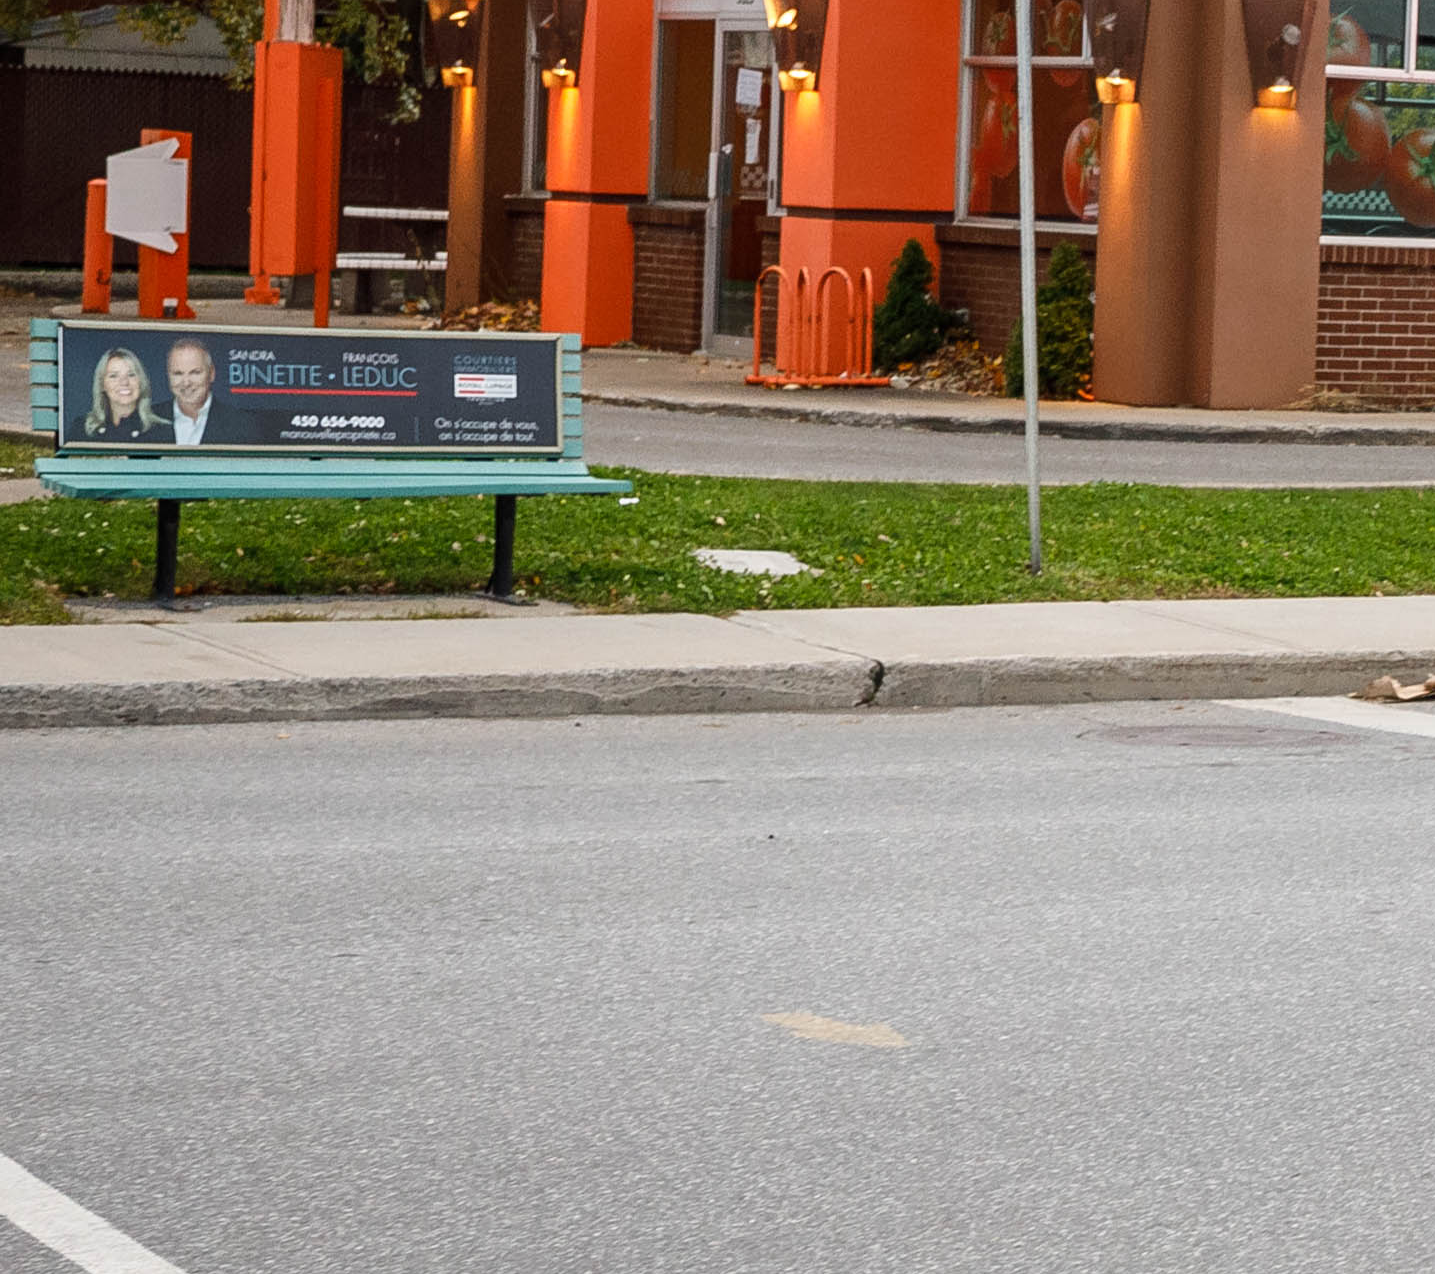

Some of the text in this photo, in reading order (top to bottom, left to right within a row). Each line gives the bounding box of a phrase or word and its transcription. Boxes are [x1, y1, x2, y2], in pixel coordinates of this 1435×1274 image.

[229, 350, 276, 361] SANDRA
[343, 352, 399, 366] FRANÇOIS
[229, 363, 418, 389] BINETTE LEDUC
[291, 415, 385, 428] 450 656-9000
